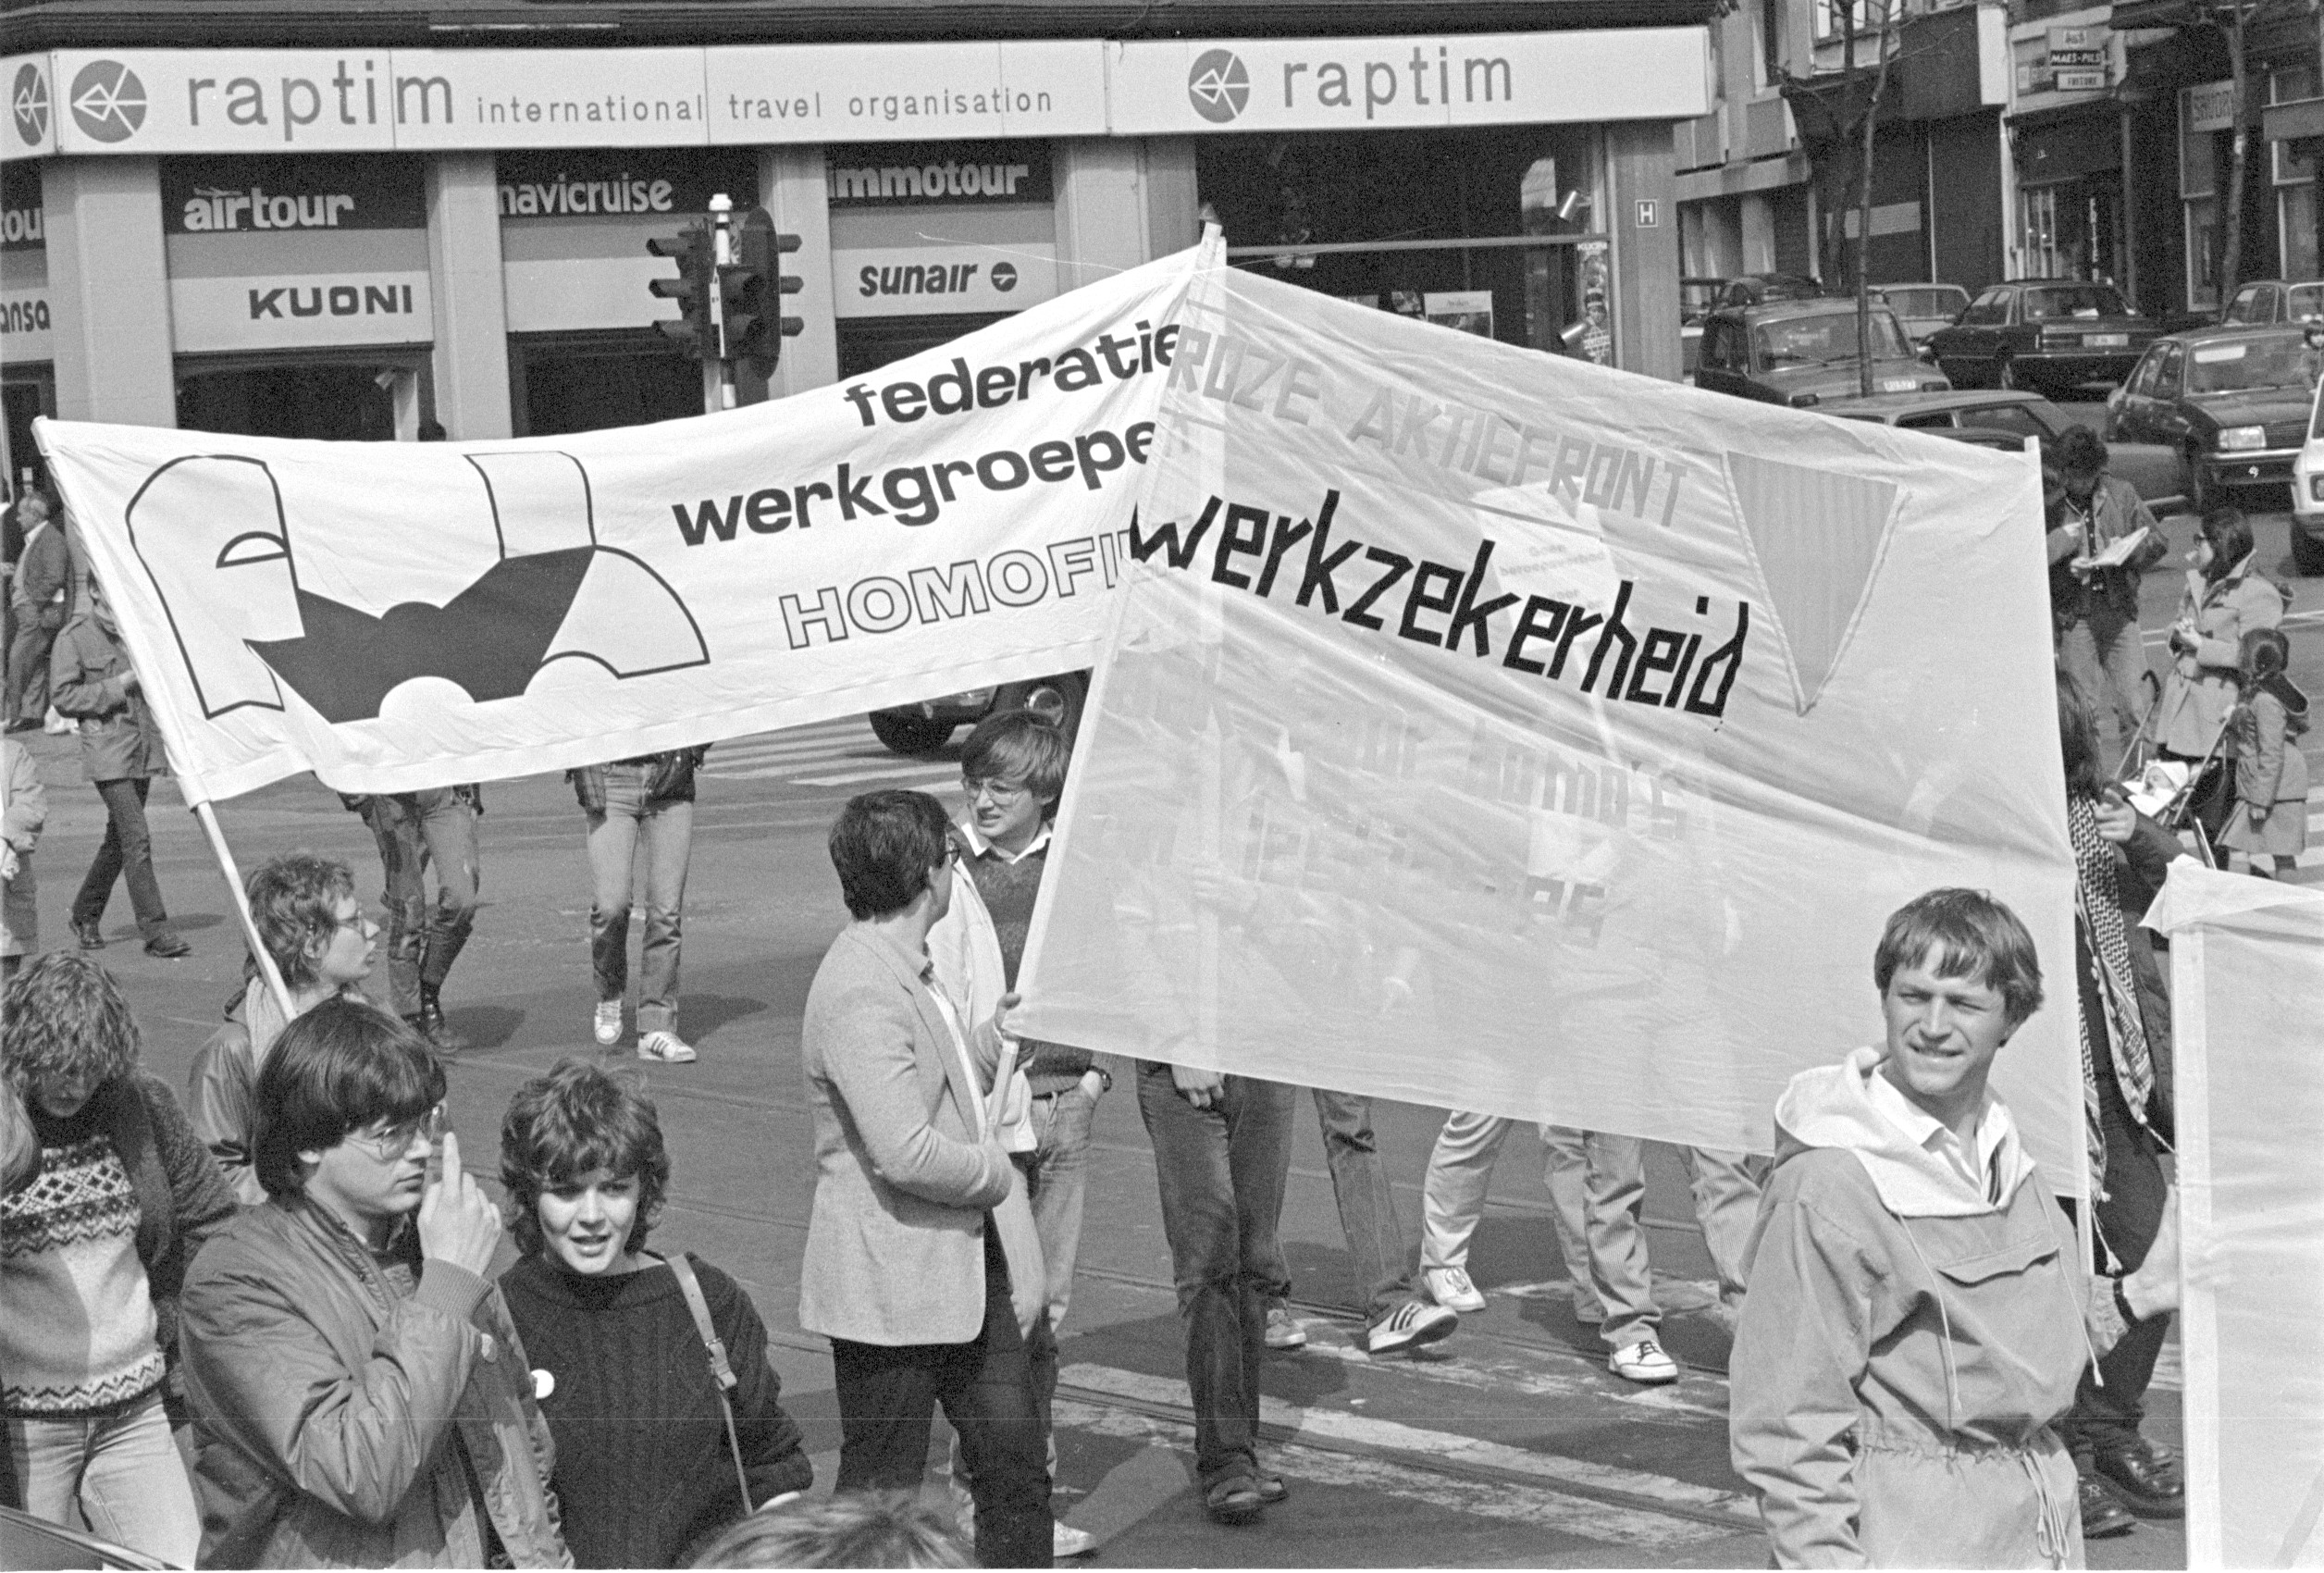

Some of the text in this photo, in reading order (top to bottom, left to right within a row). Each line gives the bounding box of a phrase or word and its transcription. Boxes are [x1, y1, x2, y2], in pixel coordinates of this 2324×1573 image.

[188, 59, 1052, 142] raptim international travel organisation
[1283, 46, 1513, 119] raptim
[184, 187, 355, 231] airtour
[498, 172, 674, 215] navicruise
[1639, 204, 1654, 223] H
[249, 284, 414, 320] KUONI
[859, 263, 979, 297] sunair
[844, 319, 1181, 427] federatie
[1167, 325, 1688, 528] ROZE AKTIEFRONT
[1130, 489, 1749, 717] werkzekerheid
